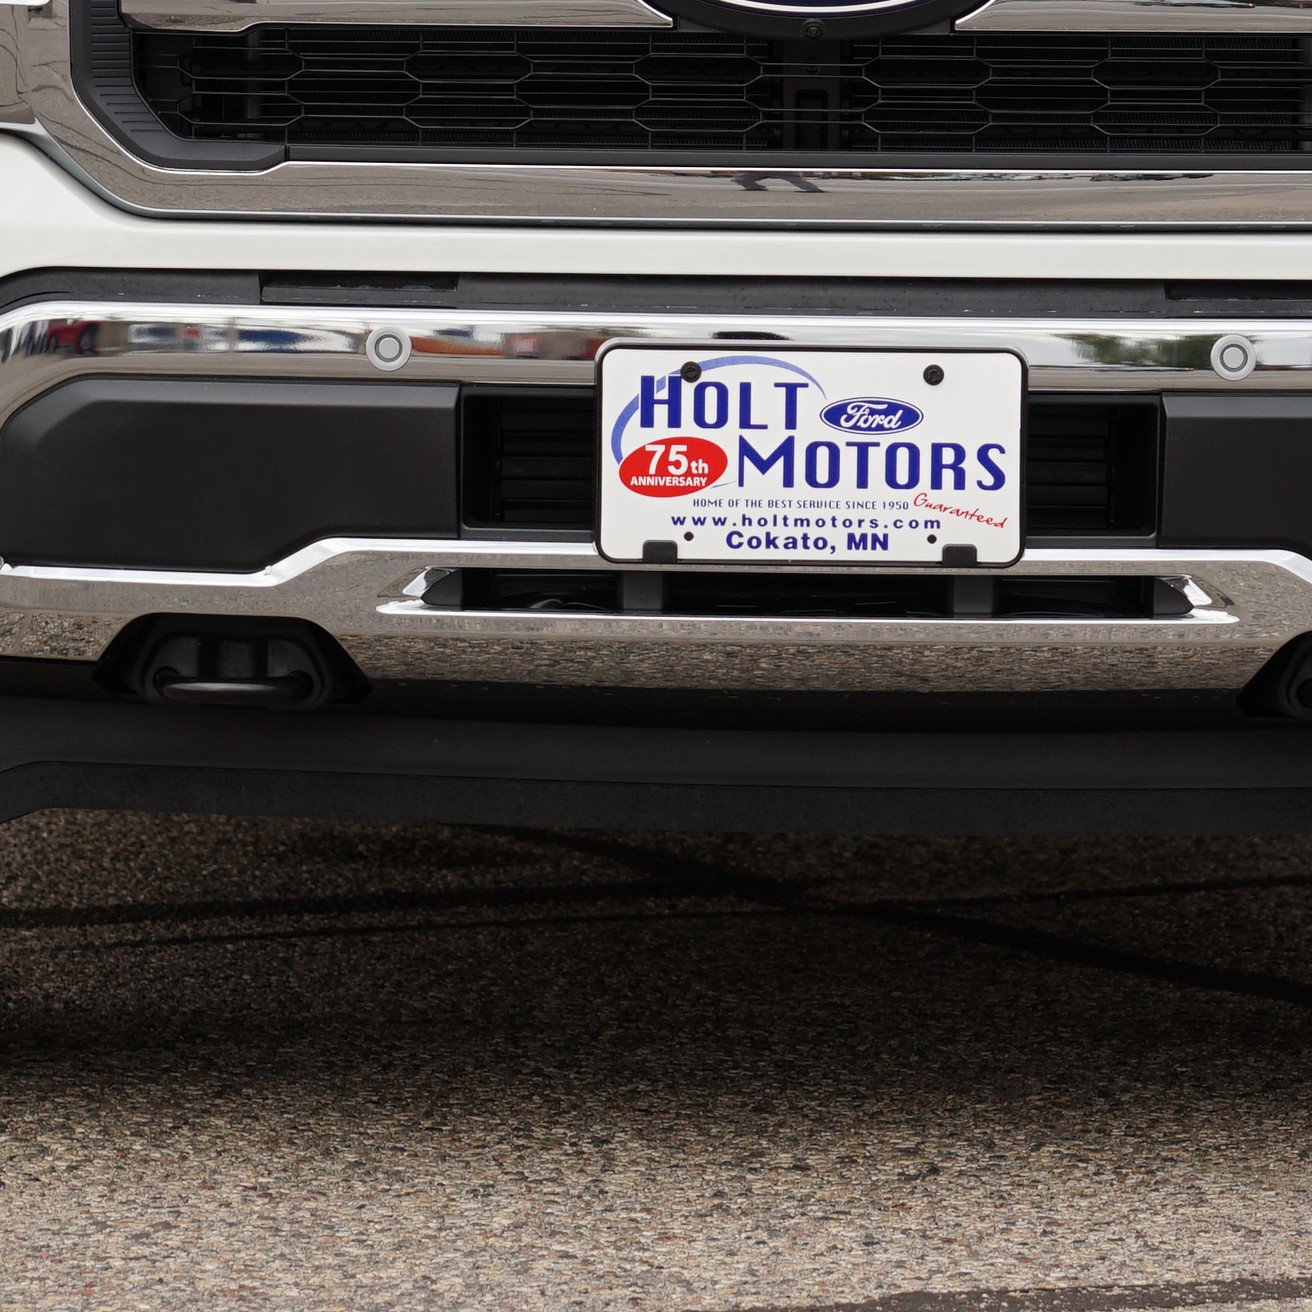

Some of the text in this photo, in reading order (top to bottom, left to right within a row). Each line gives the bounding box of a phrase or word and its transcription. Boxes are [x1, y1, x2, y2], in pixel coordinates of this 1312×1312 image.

[640, 375, 809, 430] HOLT
[840, 401, 904, 429] Ford
[644, 444, 709, 475] 75th
[738, 435, 1006, 491] MOTORS
[630, 476, 708, 487] ANNIVERSARY
[693, 499, 909, 510] HOME OF THE BEST SERVICE SINCE 1950
[913, 492, 1008, 528] Guaranteed
[671, 514, 941, 529] www.holtmotors.com
[725, 530, 889, 554] Cokato, MN
